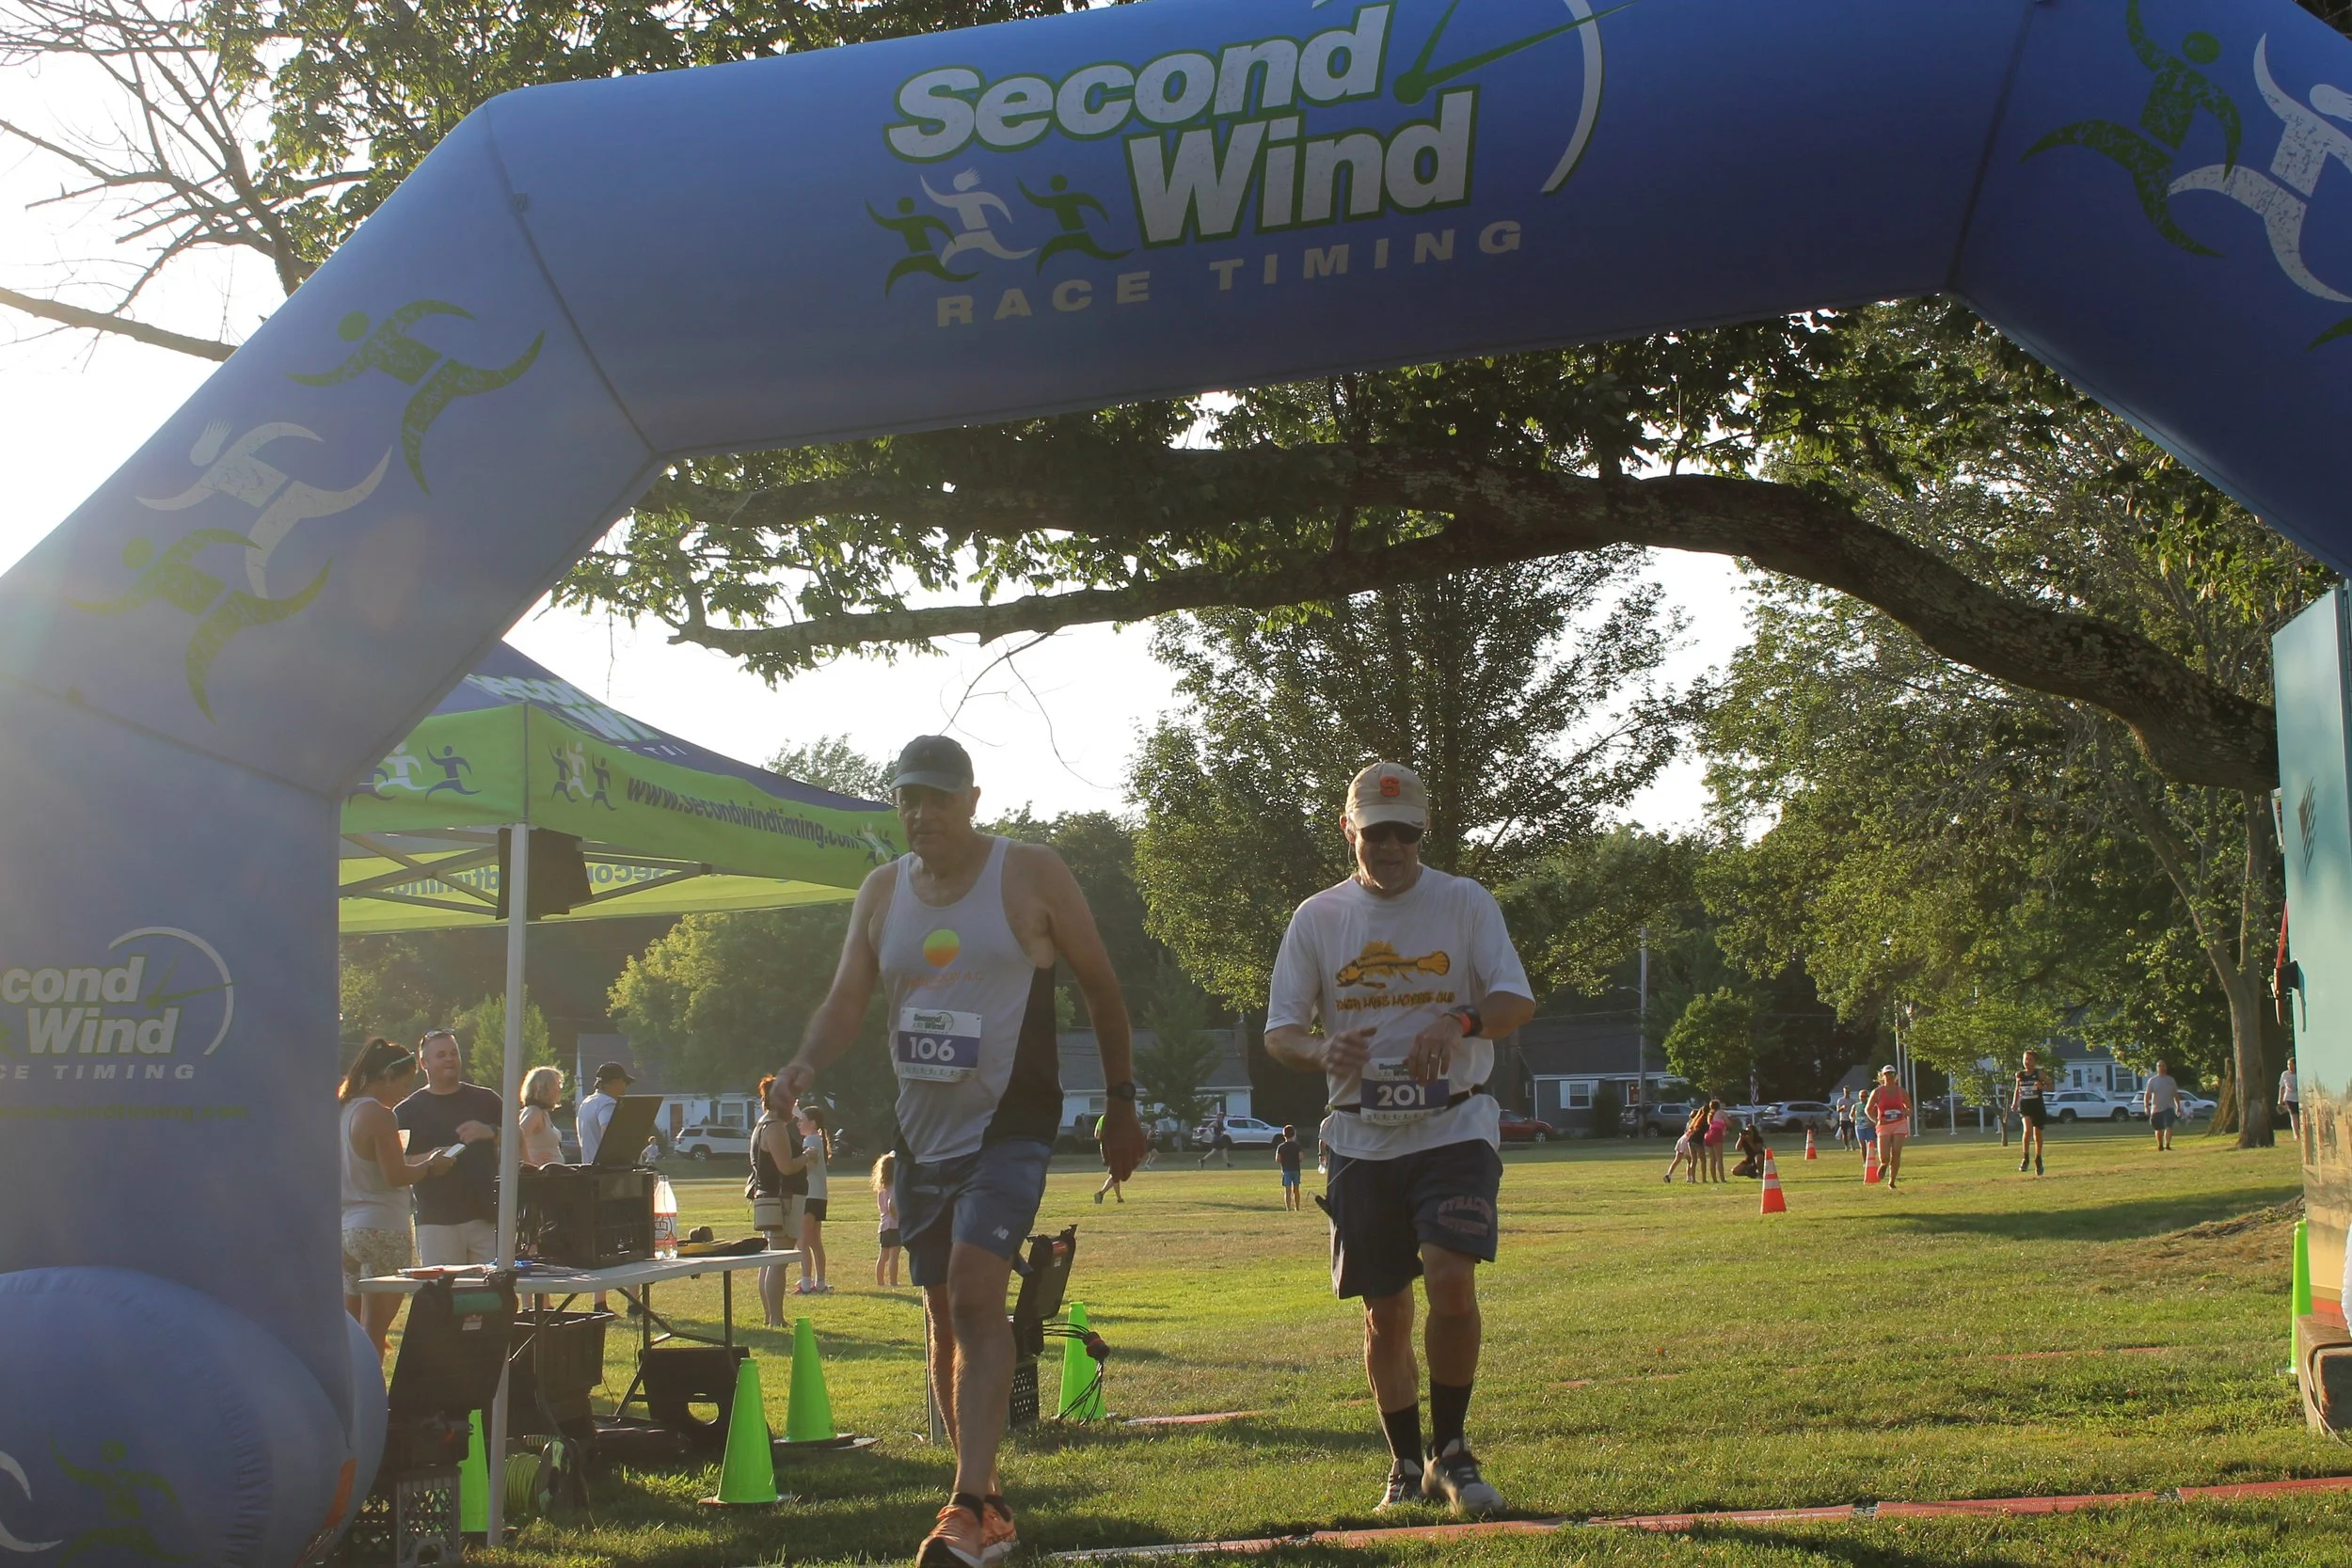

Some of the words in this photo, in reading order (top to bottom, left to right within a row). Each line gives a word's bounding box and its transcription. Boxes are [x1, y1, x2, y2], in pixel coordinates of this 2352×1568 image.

[885, 3, 1394, 162] Second
[1125, 86, 1478, 248] Wind
[936, 270, 1150, 327] RACE
[1210, 220, 1521, 292] TIMING
[1379, 775, 1401, 798] S
[26, 1006, 181, 1054] Wind
[909, 1037, 955, 1062] 106
[54, 1064, 196, 1080] TIMING
[1376, 1085, 1425, 1106] 201
